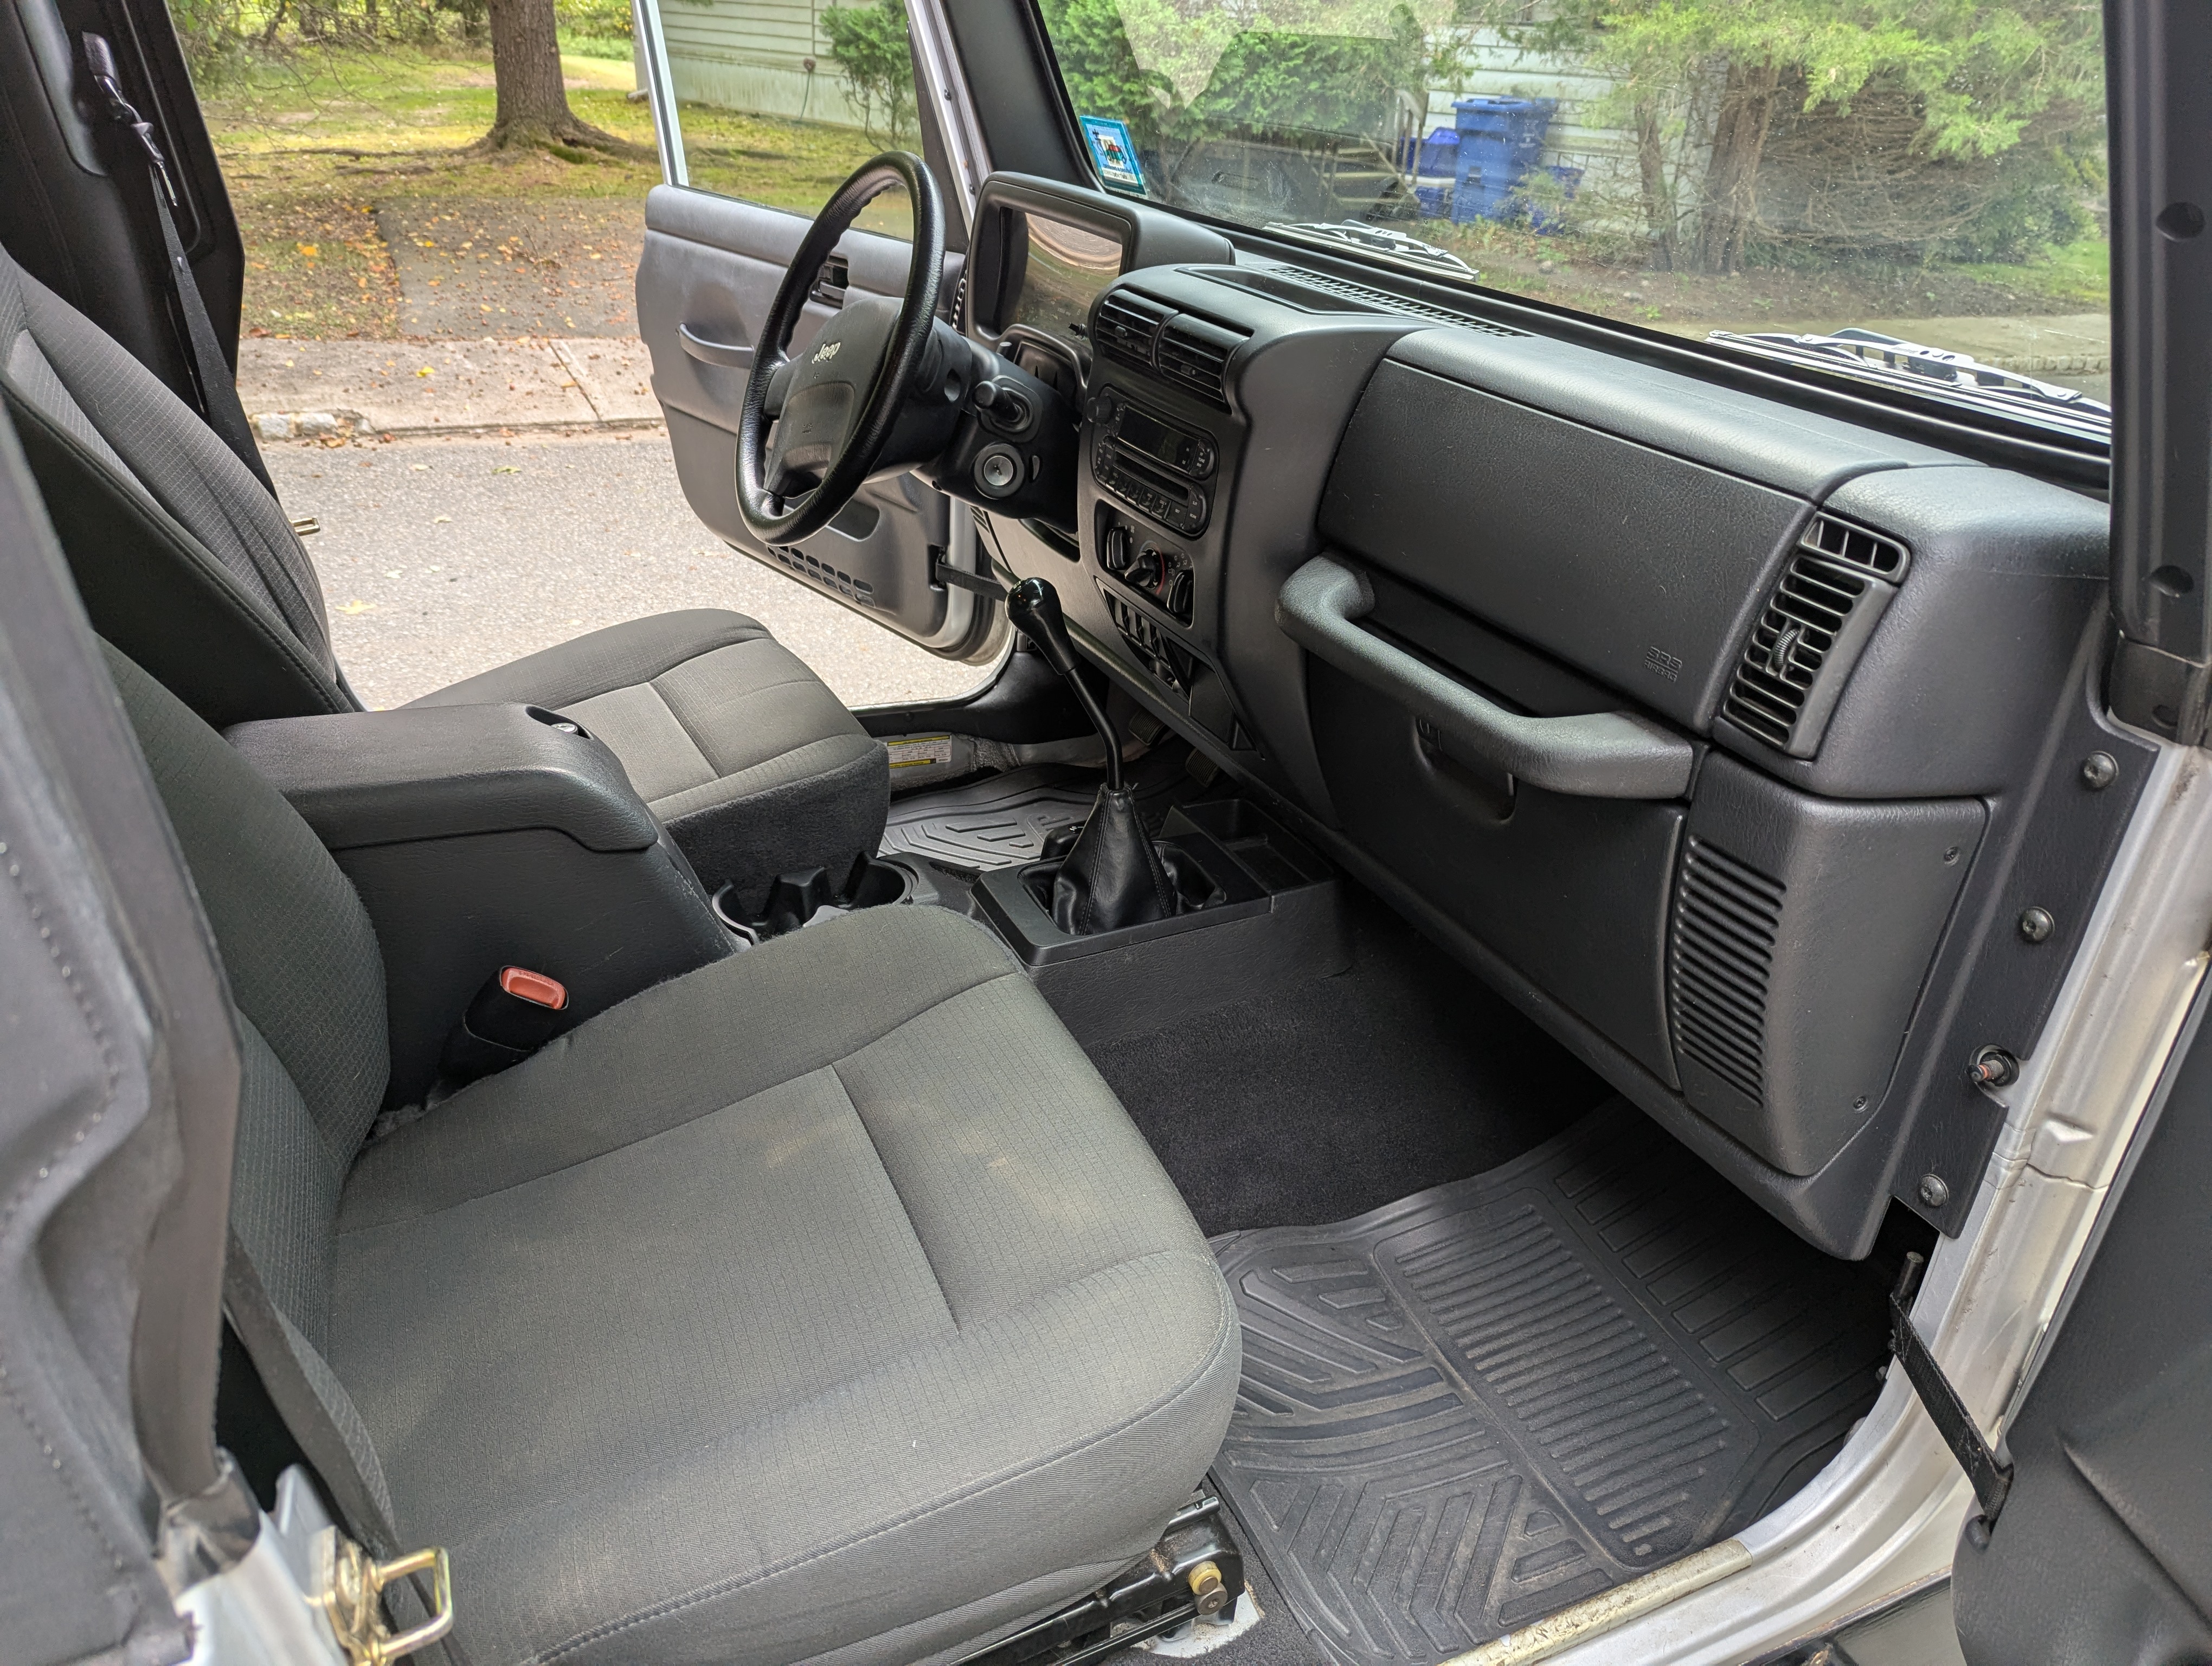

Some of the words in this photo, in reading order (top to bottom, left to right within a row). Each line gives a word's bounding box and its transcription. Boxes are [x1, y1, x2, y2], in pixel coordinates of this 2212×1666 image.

[812, 342, 841, 364] Jeep
[1647, 646, 1682, 669] SRS
[1644, 659, 1677, 683] AIRBAG
